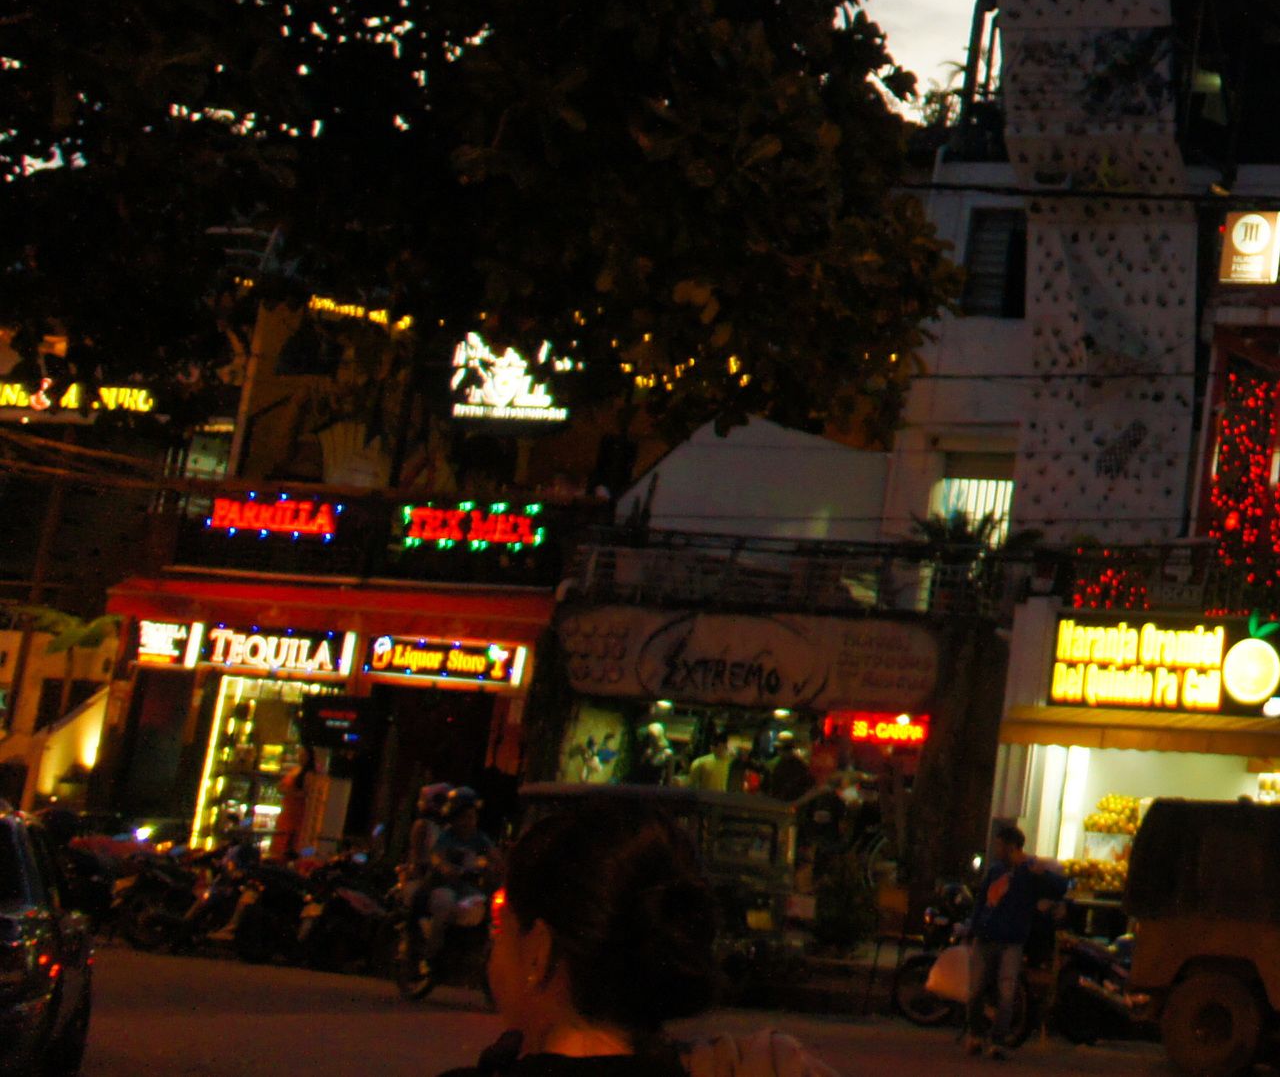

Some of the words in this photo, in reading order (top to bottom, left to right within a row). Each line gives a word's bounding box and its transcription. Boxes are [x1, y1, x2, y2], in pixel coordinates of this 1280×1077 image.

[212, 497, 336, 535] PARRILLA
[407, 506, 465, 541] TEX
[467, 509, 534, 545] MEX
[209, 627, 333, 671] TEQUILA
[392, 644, 444, 672] Liquor
[447, 649, 486, 674] Store
[1057, 619, 1138, 665] Naranja
[1139, 622, 1224, 669] Oromiel
